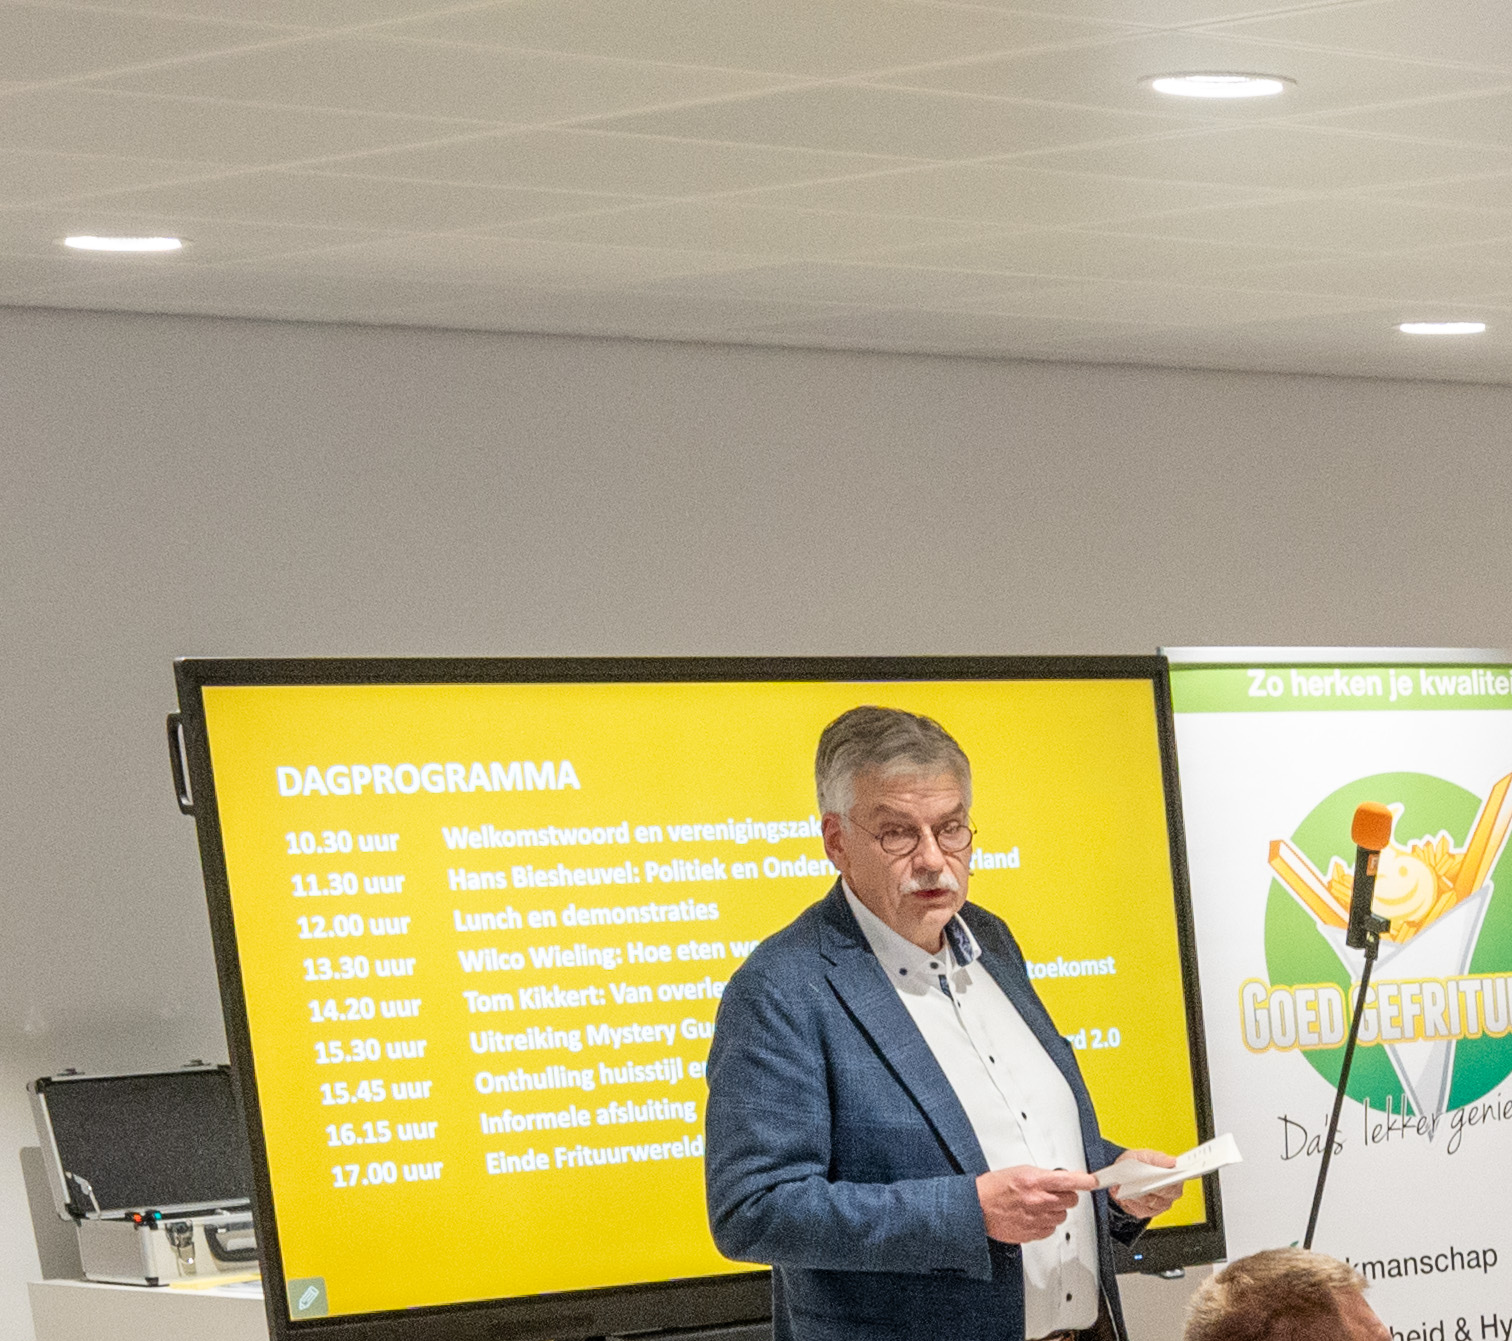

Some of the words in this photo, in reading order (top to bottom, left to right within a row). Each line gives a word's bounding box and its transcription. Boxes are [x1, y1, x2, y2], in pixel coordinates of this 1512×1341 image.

[1247, 669, 1284, 697] Zo
[1292, 668, 1383, 697] herken
[1388, 669, 1413, 701] je
[276, 760, 581, 797] DAGPROGRAMMA
[285, 830, 353, 855] 10.30
[358, 833, 400, 852] uur
[441, 821, 629, 850] Welkomstwoord
[635, 825, 663, 842] en
[667, 815, 822, 844] verenigingszak
[291, 872, 358, 897] 11.30
[363, 875, 405, 894] uur
[447, 868, 507, 891] Hans
[511, 861, 640, 889] Biesheuvel:
[645, 858, 727, 883] Politiek
[731, 863, 758, 880] en
[297, 914, 364, 939] 12.00
[369, 916, 411, 935] uur
[453, 906, 522, 932] Lunch
[527, 909, 557, 928] en
[562, 899, 719, 927] demonstraties
[303, 955, 369, 981] 13.30
[375, 958, 416, 977] uur
[457, 948, 525, 973] Wilco
[528, 944, 621, 970] Wieling:
[627, 941, 672, 964] Hoe
[677, 940, 725, 961] eten
[1027, 956, 1116, 979] toekomst
[308, 997, 375, 1022] 14.20
[380, 999, 422, 1018] uur
[463, 990, 514, 1013] Tom
[518, 984, 606, 1009] Kikkert:
[609, 982, 653, 1004] Van
[1242, 980, 1344, 1050] GOED
[314, 1038, 381, 1064] 15.30
[385, 1040, 427, 1059] uur
[469, 1026, 582, 1053] Uitreiking
[586, 1023, 676, 1049] Mystery
[1091, 1027, 1121, 1048] 2.0
[475, 1065, 595, 1094] Onthulling
[598, 1057, 684, 1085] huisstijl
[320, 1079, 386, 1105] 15.45
[391, 1080, 432, 1100] uur
[480, 1105, 591, 1134] Informele
[596, 1098, 697, 1125] afsluiting
[1365, 1096, 1439, 1146] lekker
[326, 1120, 391, 1146] 16.15
[397, 1121, 438, 1141] uur
[486, 1148, 549, 1175] Einde
[554, 1134, 705, 1169] Frituurwereld
[331, 1161, 397, 1188] 17.00
[403, 1162, 443, 1182] uur
[1346, 1247, 1498, 1280] kmanschap
